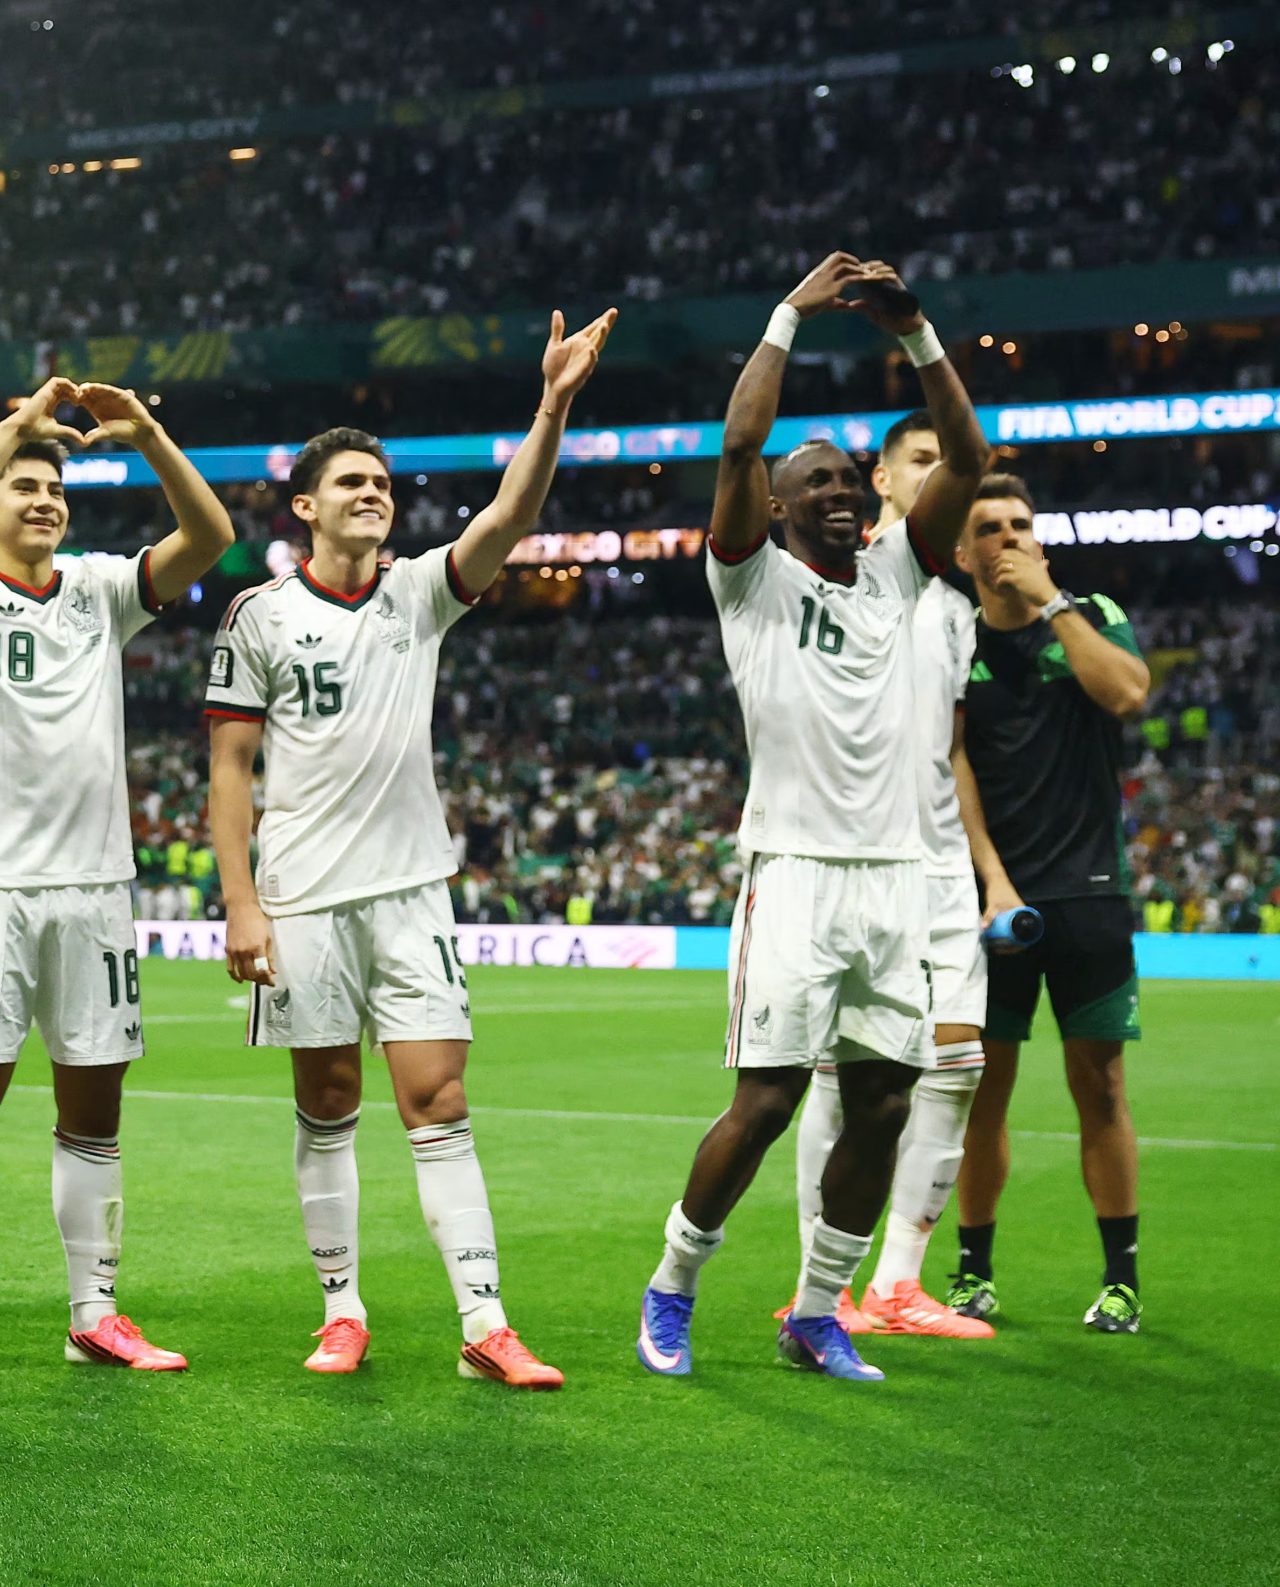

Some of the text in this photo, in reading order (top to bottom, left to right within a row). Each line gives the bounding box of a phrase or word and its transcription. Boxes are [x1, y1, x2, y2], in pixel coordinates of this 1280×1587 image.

[998, 405, 1074, 441] FIFA
[1074, 398, 1199, 436] WORLD
[1201, 393, 1275, 430] CUP
[624, 528, 704, 561] CITY
[1032, 503, 1277, 546] FA WORLD CUP
[798, 595, 845, 655] 16
[292, 661, 342, 718] 15
[477, 934, 590, 967] RICA
[103, 948, 139, 1009] 18
